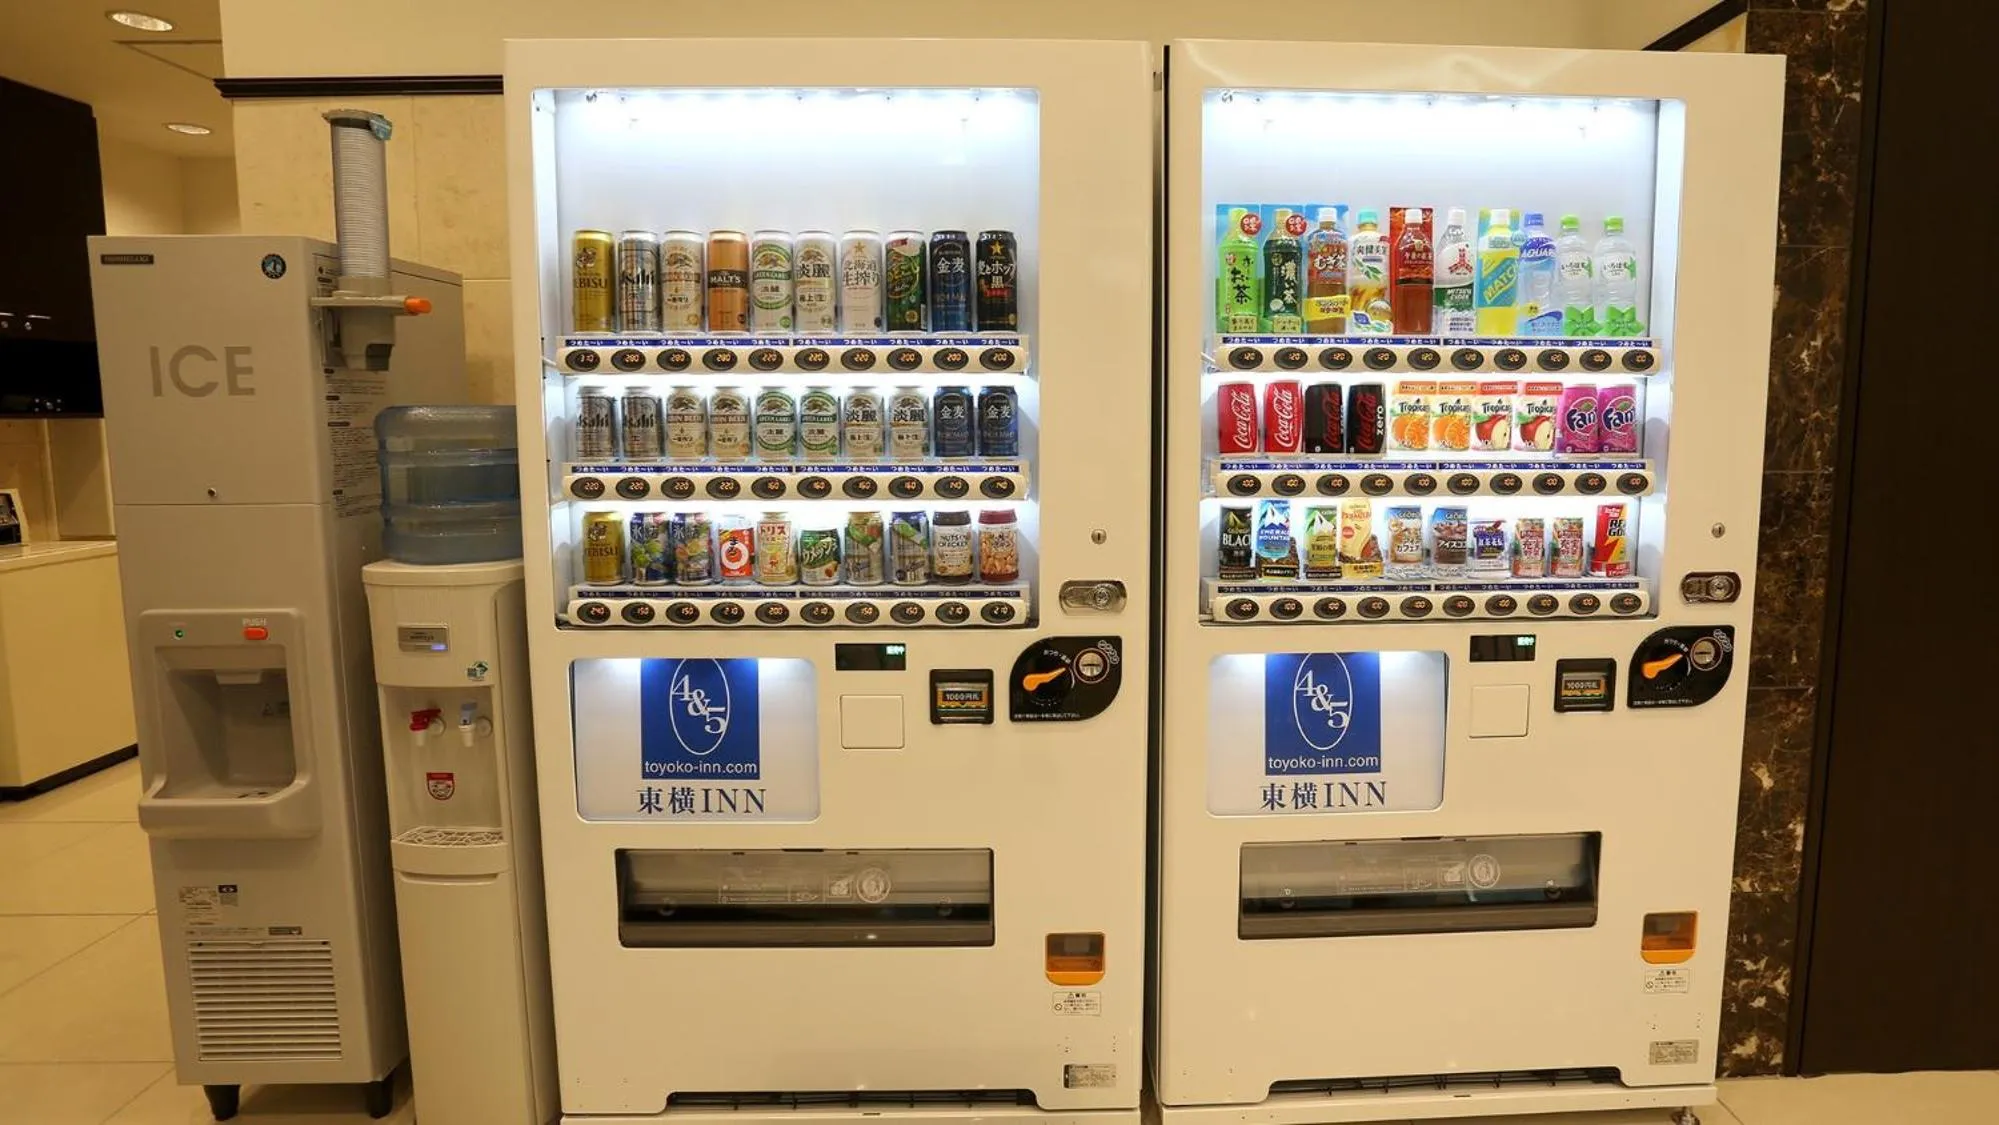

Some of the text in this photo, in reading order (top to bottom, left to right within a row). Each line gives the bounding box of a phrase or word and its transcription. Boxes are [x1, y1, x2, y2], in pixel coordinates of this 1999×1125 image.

[936, 256, 966, 274] 金麦
[992, 275, 1004, 289] 黒
[149, 344, 255, 397] ICE
[846, 409, 877, 423] 淡麗
[893, 409, 925, 422] 淡麗
[940, 405, 965, 419] 金麦
[988, 405, 1012, 419] 金麦
[1231, 388, 1253, 449] Coca-Cola
[1273, 387, 1294, 447] Coca-Cola
[1376, 405, 1384, 436] zero
[1566, 406, 1597, 432] Fan
[1602, 406, 1635, 432] Fan
[760, 525, 787, 535] トリス
[671, 673, 727, 734] 4&5
[1294, 669, 1349, 729] 4&5
[644, 760, 758, 777] toyoko-inn.com
[1268, 755, 1379, 772] toyoko-inn.com
[636, 786, 767, 815] 東横INN
[1259, 780, 1387, 811] 東横INN
